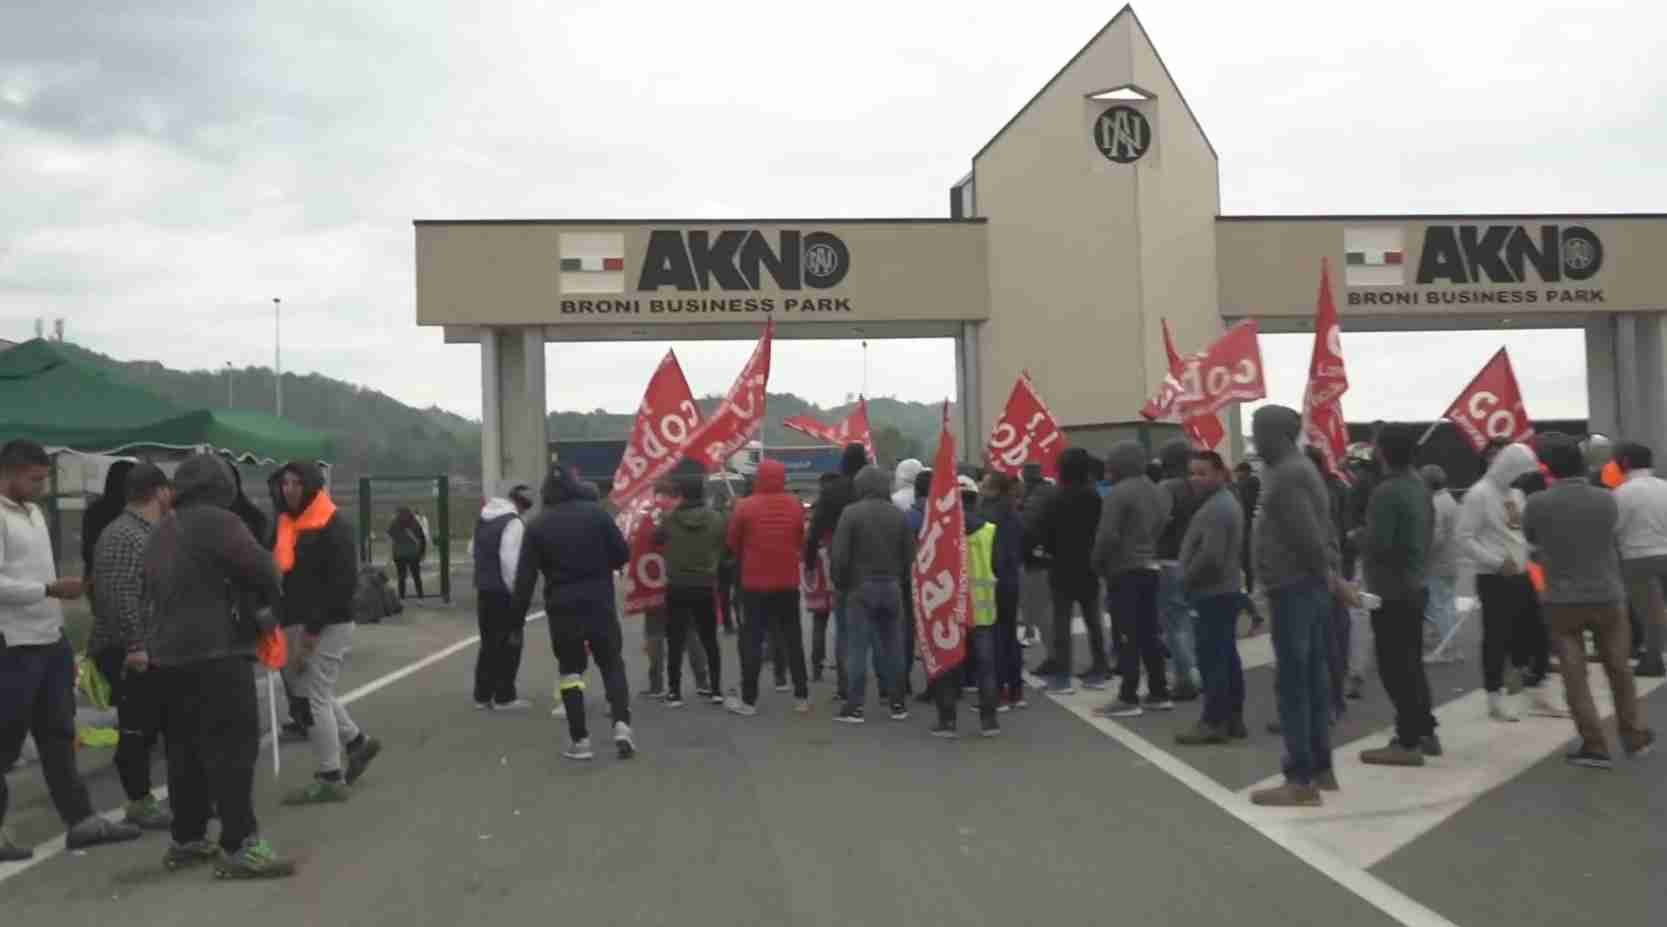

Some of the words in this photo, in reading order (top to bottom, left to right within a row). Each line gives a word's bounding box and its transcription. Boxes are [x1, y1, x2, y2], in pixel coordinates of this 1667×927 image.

[638, 230, 850, 291] AKNO
[1416, 225, 1603, 284] AKNO
[560, 299, 640, 314] BRONI
[650, 299, 775, 313] BUSINESS
[784, 298, 852, 312] PARK
[1348, 292, 1418, 305] BRONI
[1426, 291, 1537, 304] BUSINESS
[1546, 290, 1605, 303] PARK
